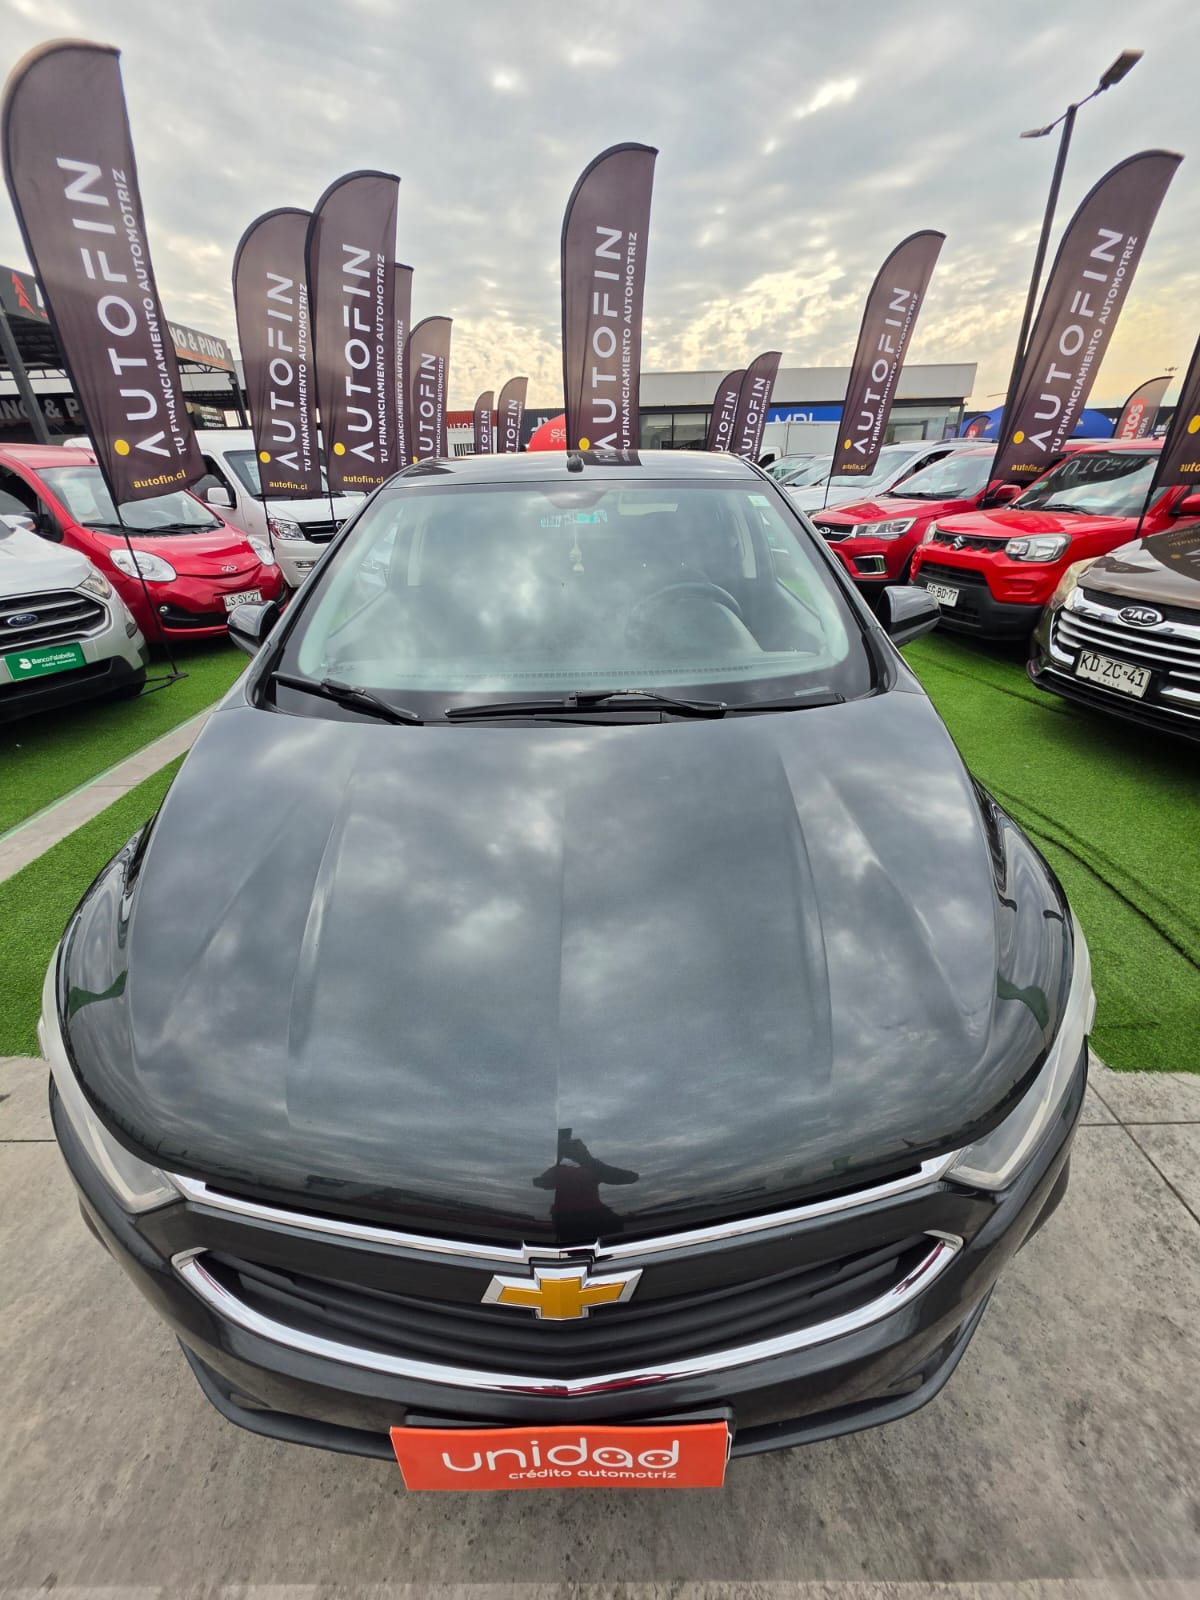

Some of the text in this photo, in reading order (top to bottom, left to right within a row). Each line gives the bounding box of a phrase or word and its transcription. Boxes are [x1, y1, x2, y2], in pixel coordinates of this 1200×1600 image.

[56, 157, 172, 457] AUTOFIN
[112, 168, 187, 455] TU FINANCIAMIENTO AUTOMOTRIZ
[342, 243, 375, 463] AUTOFIN
[376, 254, 389, 463] TU FINANCIAMIENTO AUTOMOTRIZ
[592, 225, 623, 451] AUTOFIN
[624, 232, 637, 323] AUTOMOTRIZ
[1028, 228, 1123, 452] AUTOFIN
[1051, 236, 1138, 453] TU FINANCIAMIENTO AUTOMOTRIZ
[267, 272, 300, 471] AUTOFIN
[298, 283, 312, 472] TU FINANCIAMIENTO AUTOMOTRIZ
[397, 381, 406, 452] FINANCIAMIENTO
[622, 328, 632, 436] FINANCIAMIENTO
[715, 391, 737, 451] UTOFIN
[853, 287, 911, 454] AUTOFIN
[869, 294, 919, 455] TU FINANCIAMIENTO AUTOMOTRIZ
[133, 470, 187, 489] autofin.cl
[269, 480, 308, 490] autofin.cl
[343, 474, 384, 484] autofin.cl
[442, 1437, 680, 1472] unidad
[508, 1468, 678, 1480] crédito automotriz
